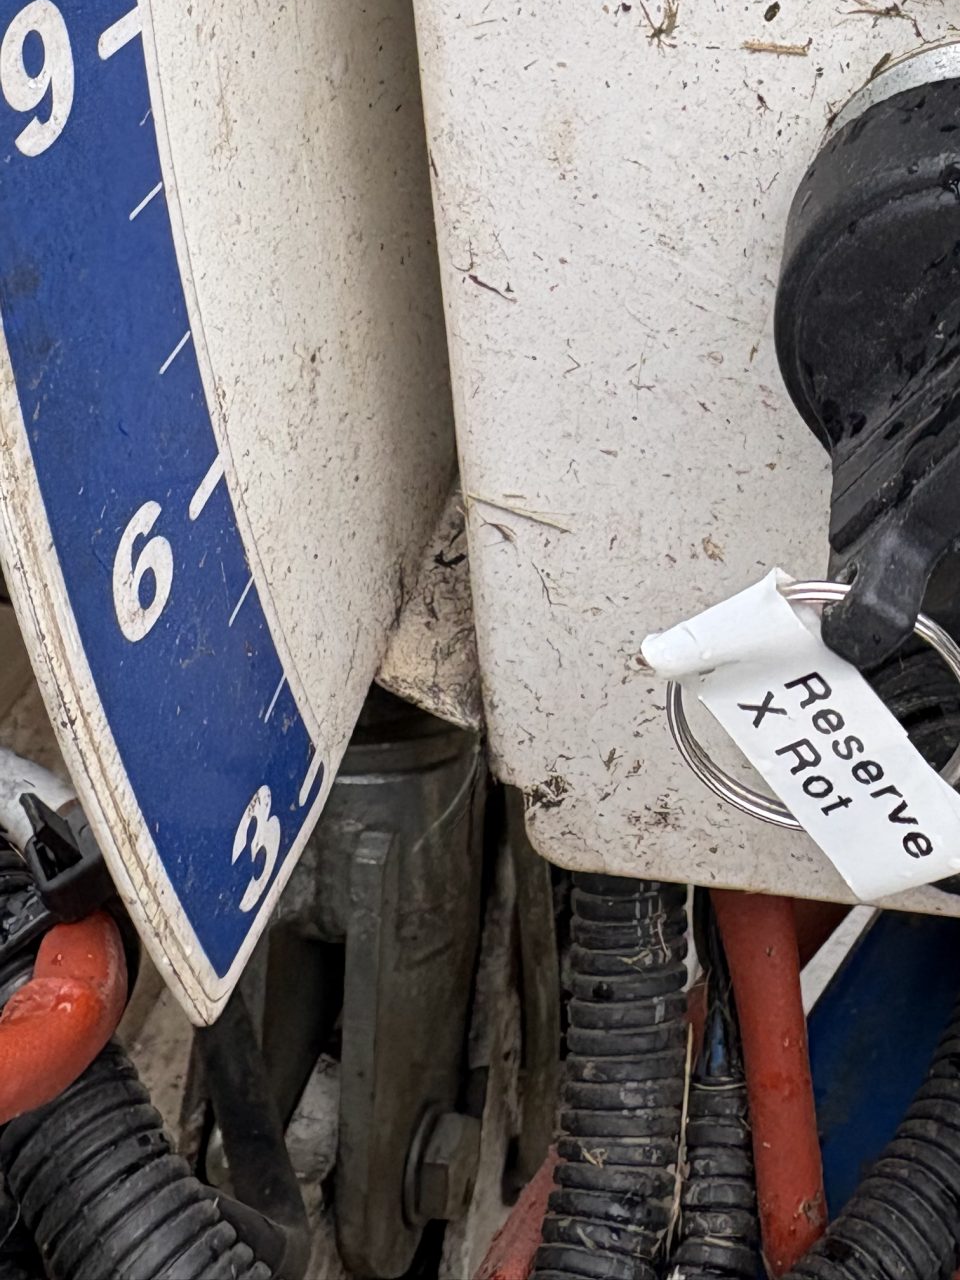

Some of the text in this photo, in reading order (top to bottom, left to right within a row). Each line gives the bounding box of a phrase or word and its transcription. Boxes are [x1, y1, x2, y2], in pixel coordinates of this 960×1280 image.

[1, 0, 74, 157] 9
[113, 500, 174, 642] 6
[775, 738, 853, 816] Rot
[784, 671, 934, 859] Reserve
[232, 784, 281, 912] 3
